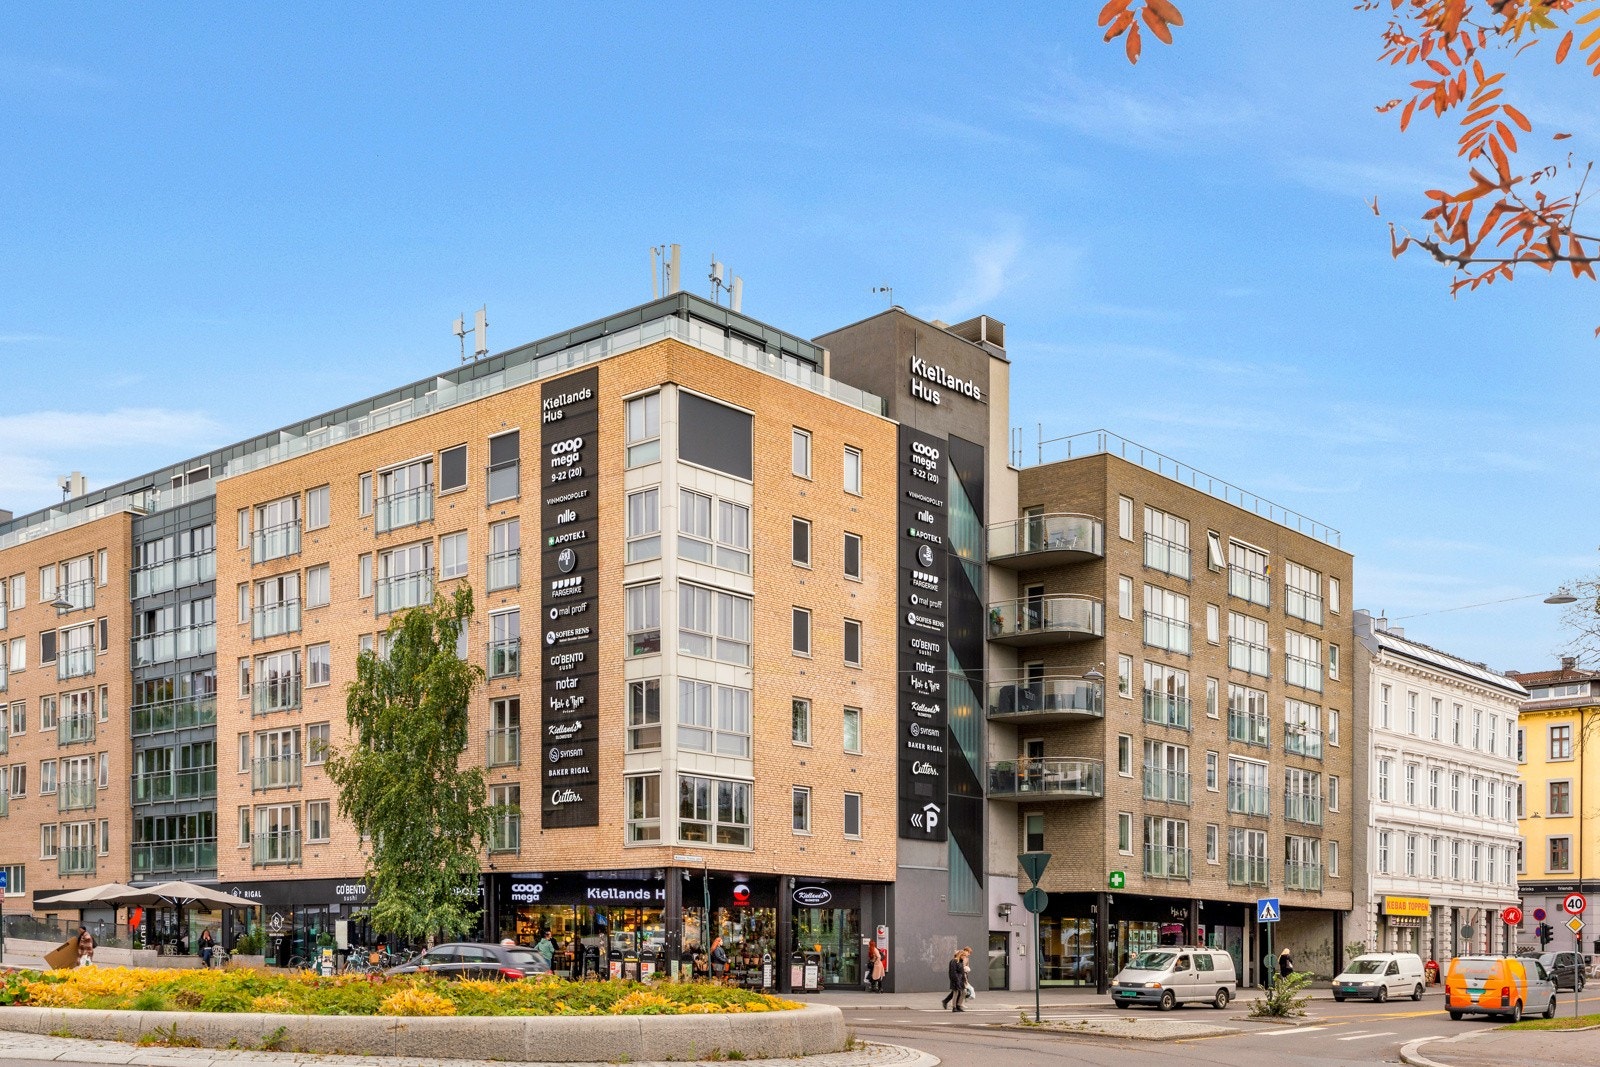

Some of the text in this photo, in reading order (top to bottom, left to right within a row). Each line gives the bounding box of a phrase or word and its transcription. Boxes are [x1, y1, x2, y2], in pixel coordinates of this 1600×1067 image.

[911, 355, 981, 400] Kiellands
[911, 377, 940, 405] Hus
[543, 387, 592, 411] Kiellands
[543, 409, 563, 423] Hus
[551, 437, 583, 455] coop
[912, 441, 940, 459] coop
[551, 452, 580, 467] mega
[912, 454, 937, 470] mega
[551, 467, 582, 482] 9-22 (20)
[912, 467, 939, 484] 9-22 (20)
[546, 489, 588, 505] VINMONOPOLET
[557, 509, 577, 524] nille
[918, 510, 934, 524] nille
[551, 586, 582, 598] FARGERIKE
[555, 629, 575, 639] SOFIES
[574, 627, 590, 635] RENS
[558, 662, 575, 671] sushi
[915, 662, 936, 674] notar
[555, 676, 579, 690] notar
[908, 741, 943, 753] BAKER RIGAL
[548, 766, 590, 777] BAKER RIGAL
[244, 890, 262, 898] RIGAL
[511, 884, 543, 895] coop
[587, 887, 666, 900] Kiellands H
[511, 893, 540, 903] mega
[1567, 898, 1583, 909] 40
[1386, 901, 1429, 911] KEBAB TOPPEN
